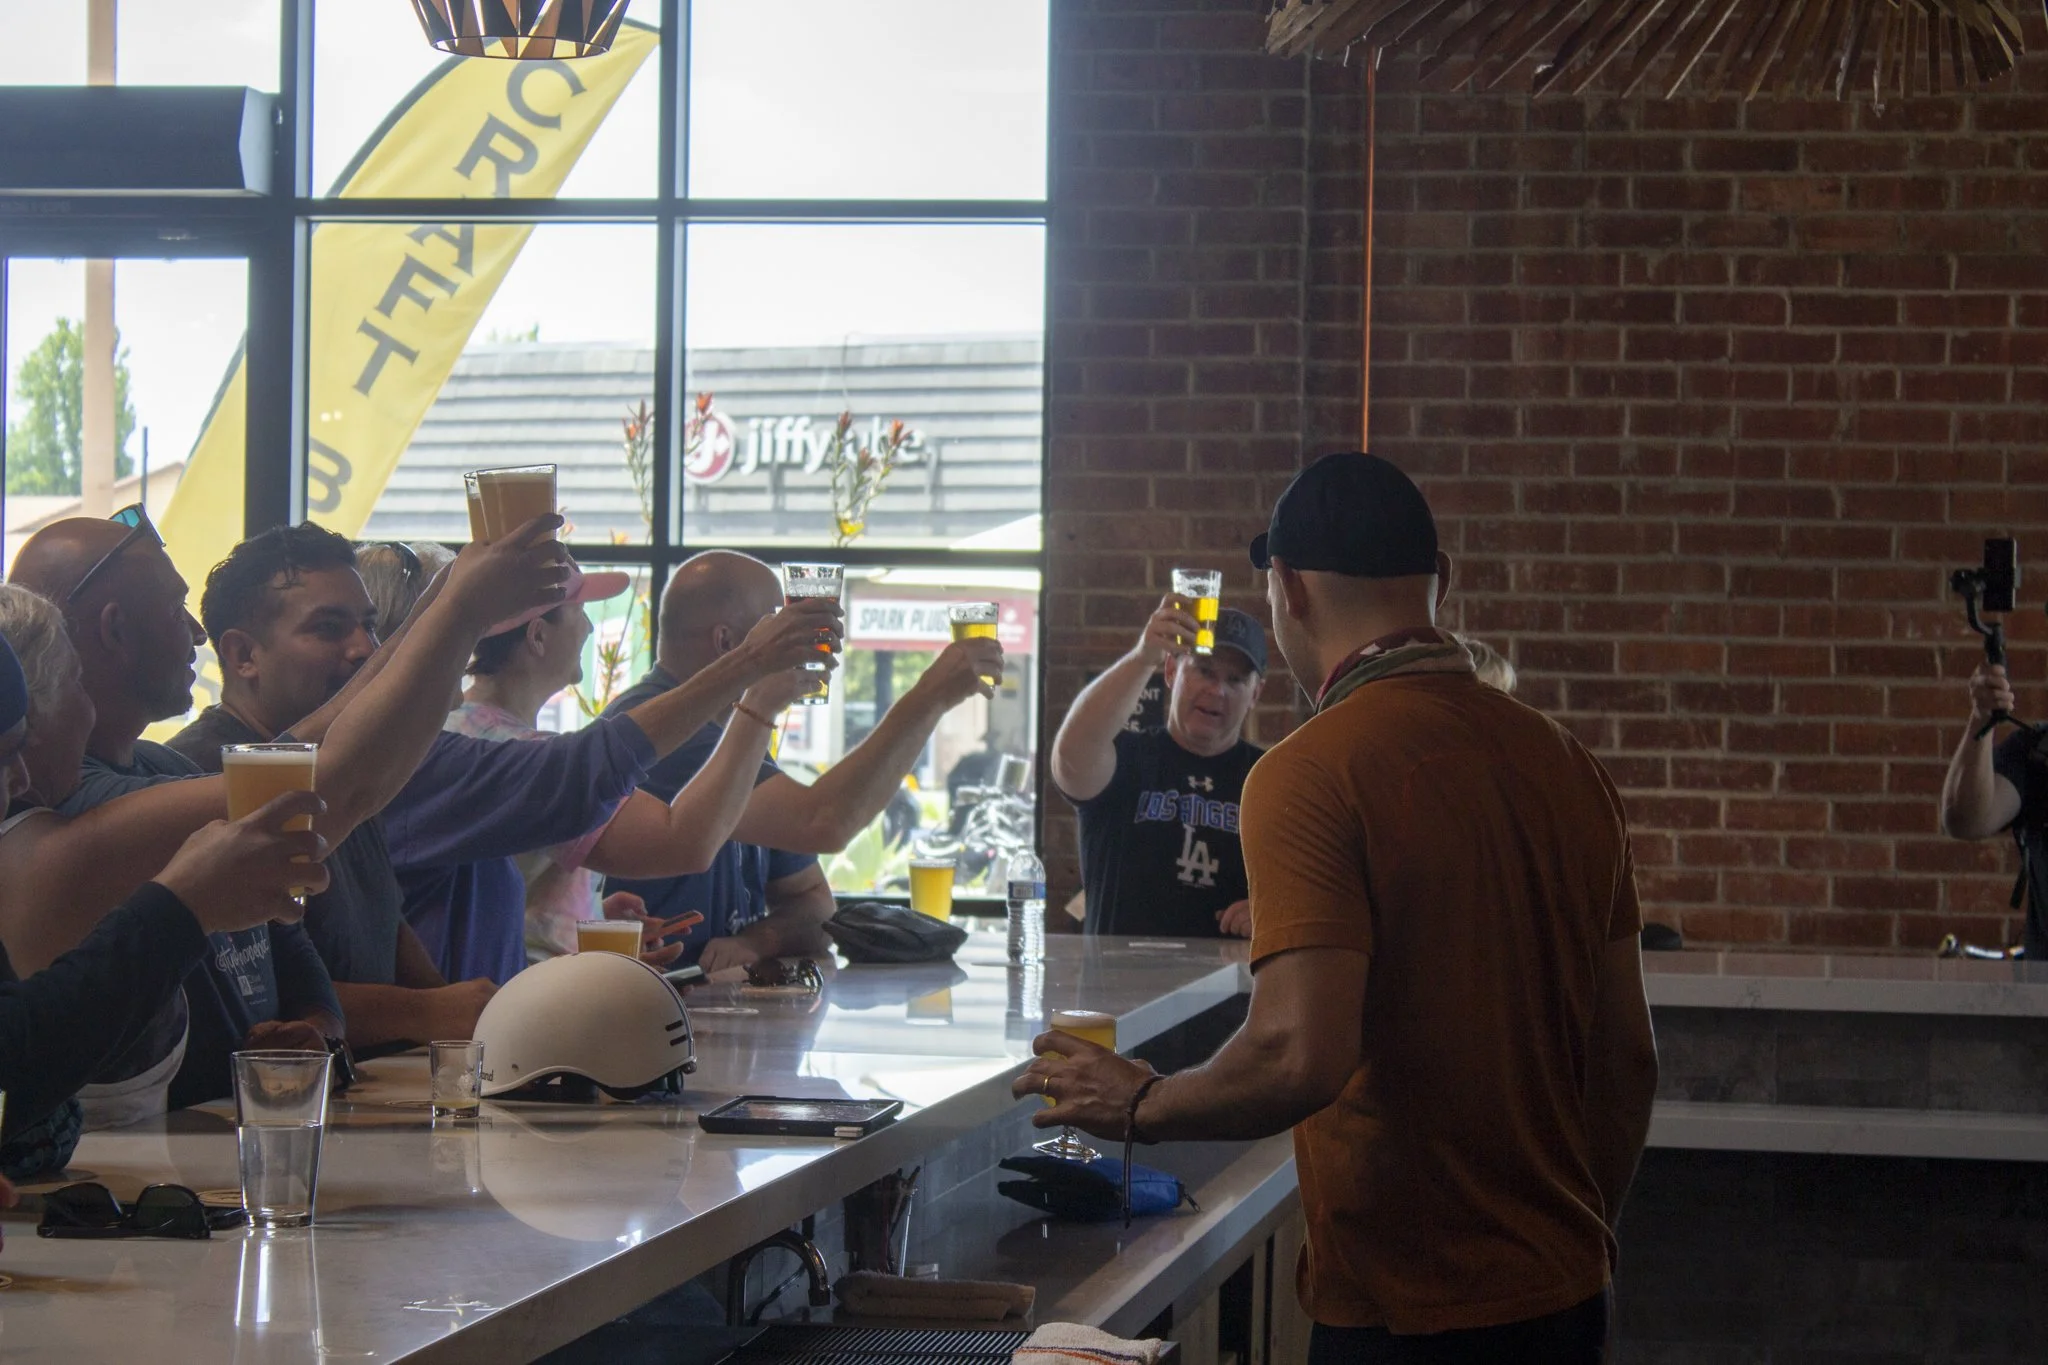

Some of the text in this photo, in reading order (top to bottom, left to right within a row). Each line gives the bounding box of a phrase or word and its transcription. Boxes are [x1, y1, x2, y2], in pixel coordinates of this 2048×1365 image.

[739, 415, 833, 476] jiffy
[859, 607, 905, 632] SPARK
[1134, 789, 1179, 824] LOS
[1176, 823, 1220, 887] LA
